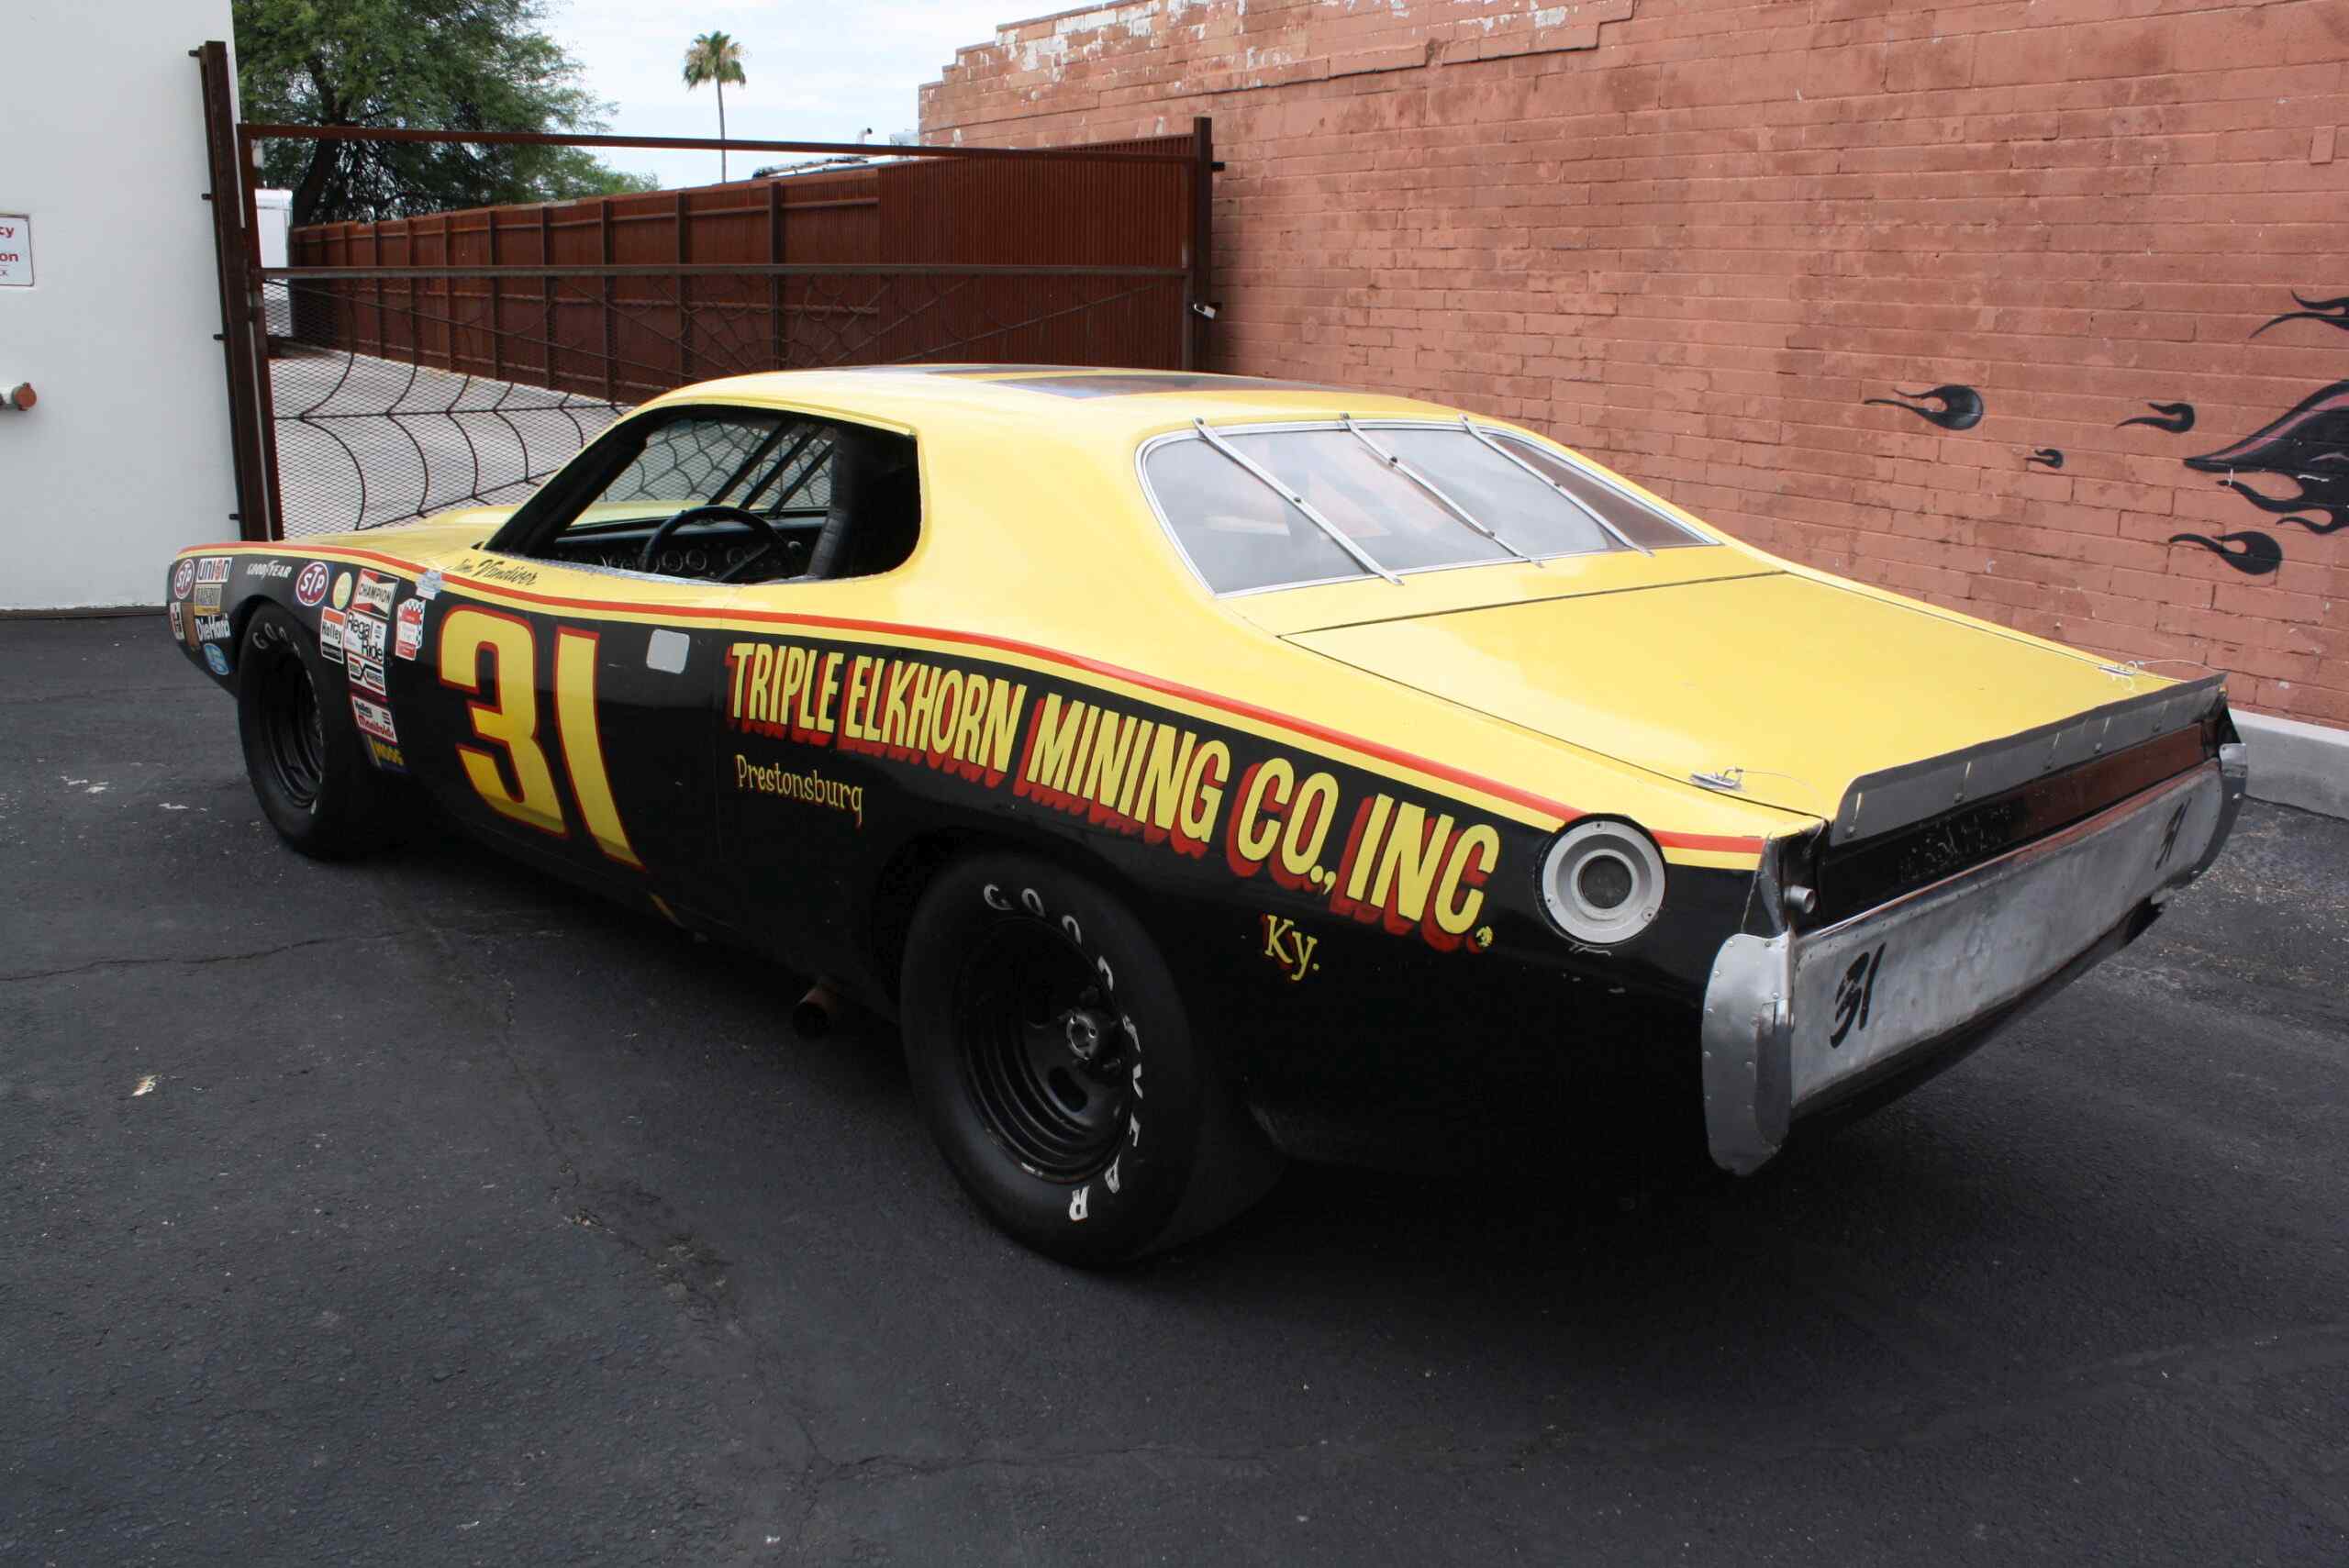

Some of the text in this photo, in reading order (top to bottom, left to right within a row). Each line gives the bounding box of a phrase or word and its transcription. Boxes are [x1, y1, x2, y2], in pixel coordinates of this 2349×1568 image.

[299, 565, 327, 596] STP
[358, 583, 393, 603] CHAMPION
[195, 613, 231, 641] DieHard
[440, 603, 648, 873] 31
[726, 642, 844, 742] TRIPLE
[839, 654, 1028, 786] ELKHORN
[1015, 693, 1231, 856] MINING
[1332, 793, 1501, 951] INC.
[735, 753, 864, 828] Prestonsburg
[1263, 913, 1321, 981] Ky.
